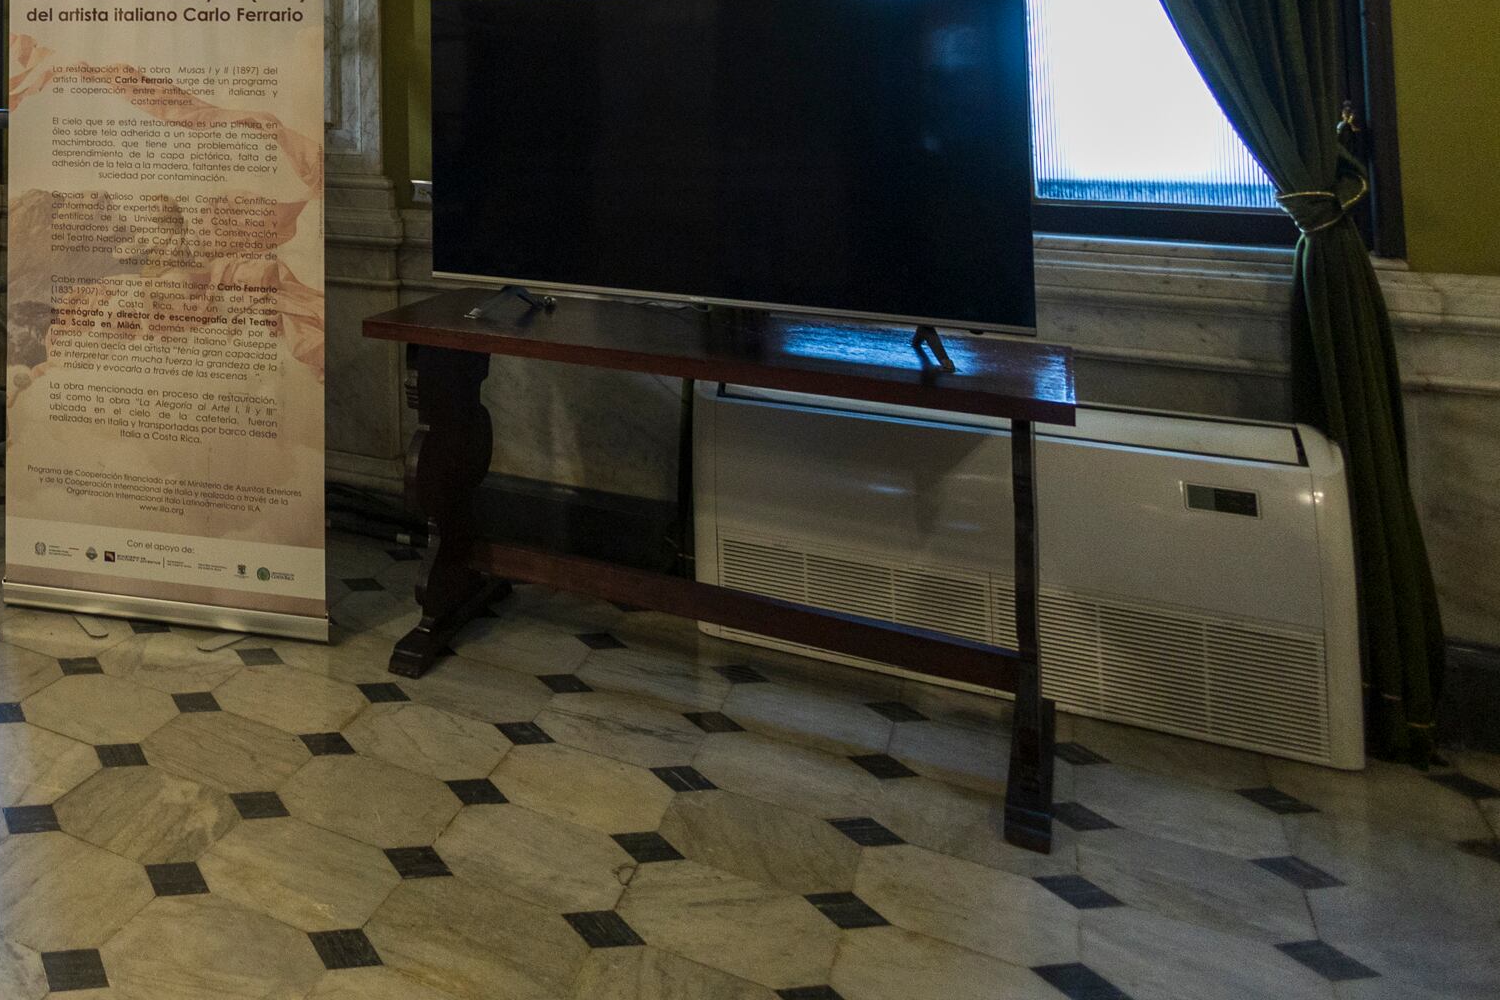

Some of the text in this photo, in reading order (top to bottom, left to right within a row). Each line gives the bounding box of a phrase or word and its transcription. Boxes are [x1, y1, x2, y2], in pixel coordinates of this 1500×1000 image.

[27, 8, 303, 22] del artista italiano Carlo Ferrario
